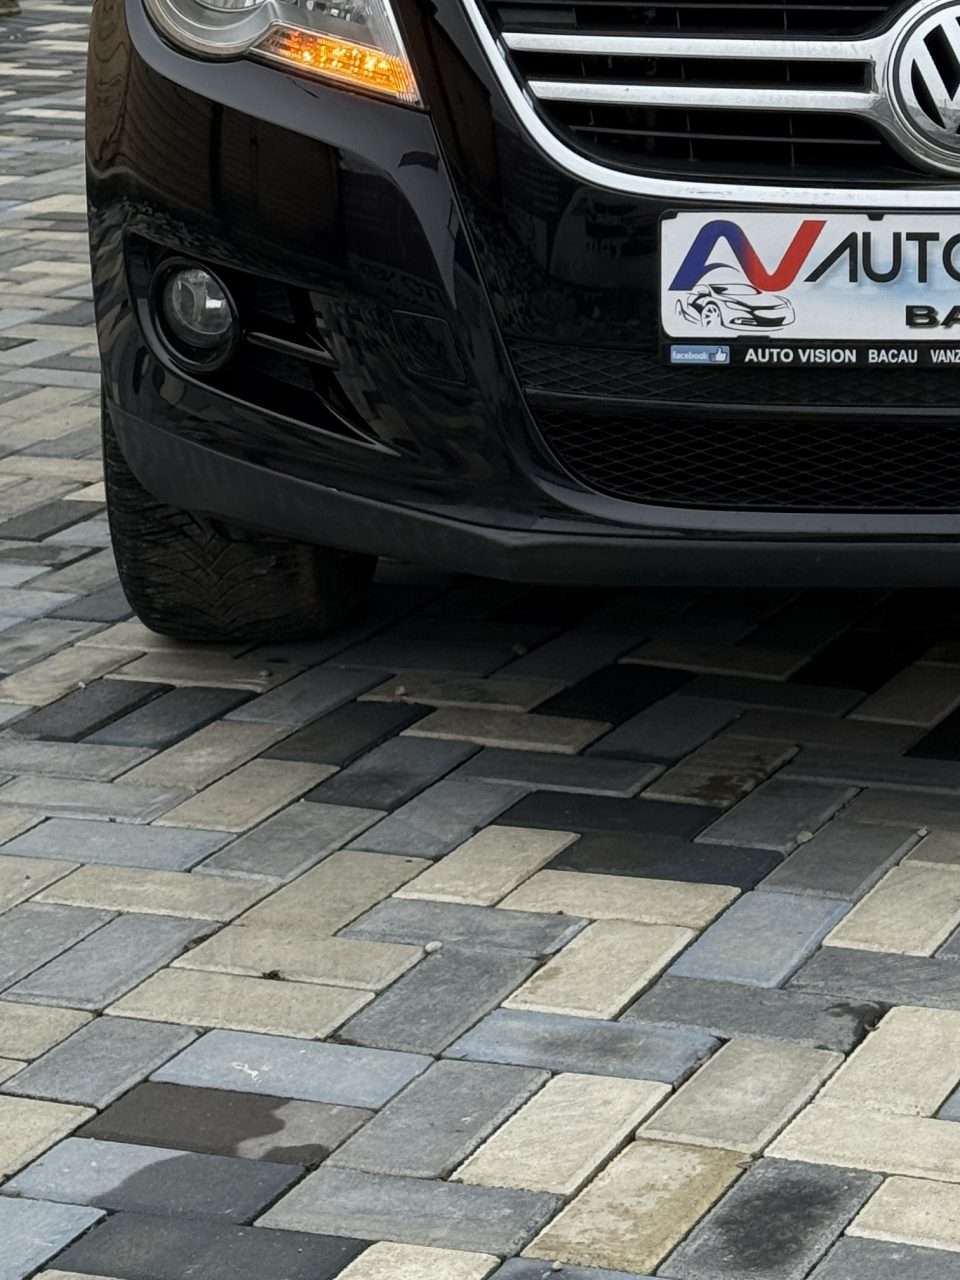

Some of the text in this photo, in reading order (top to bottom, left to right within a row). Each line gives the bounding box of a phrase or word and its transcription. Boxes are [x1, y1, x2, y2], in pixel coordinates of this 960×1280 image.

[744, 348, 794, 363] AUTO
[798, 348, 857, 363] VISION
[868, 349, 918, 363] BACAU
